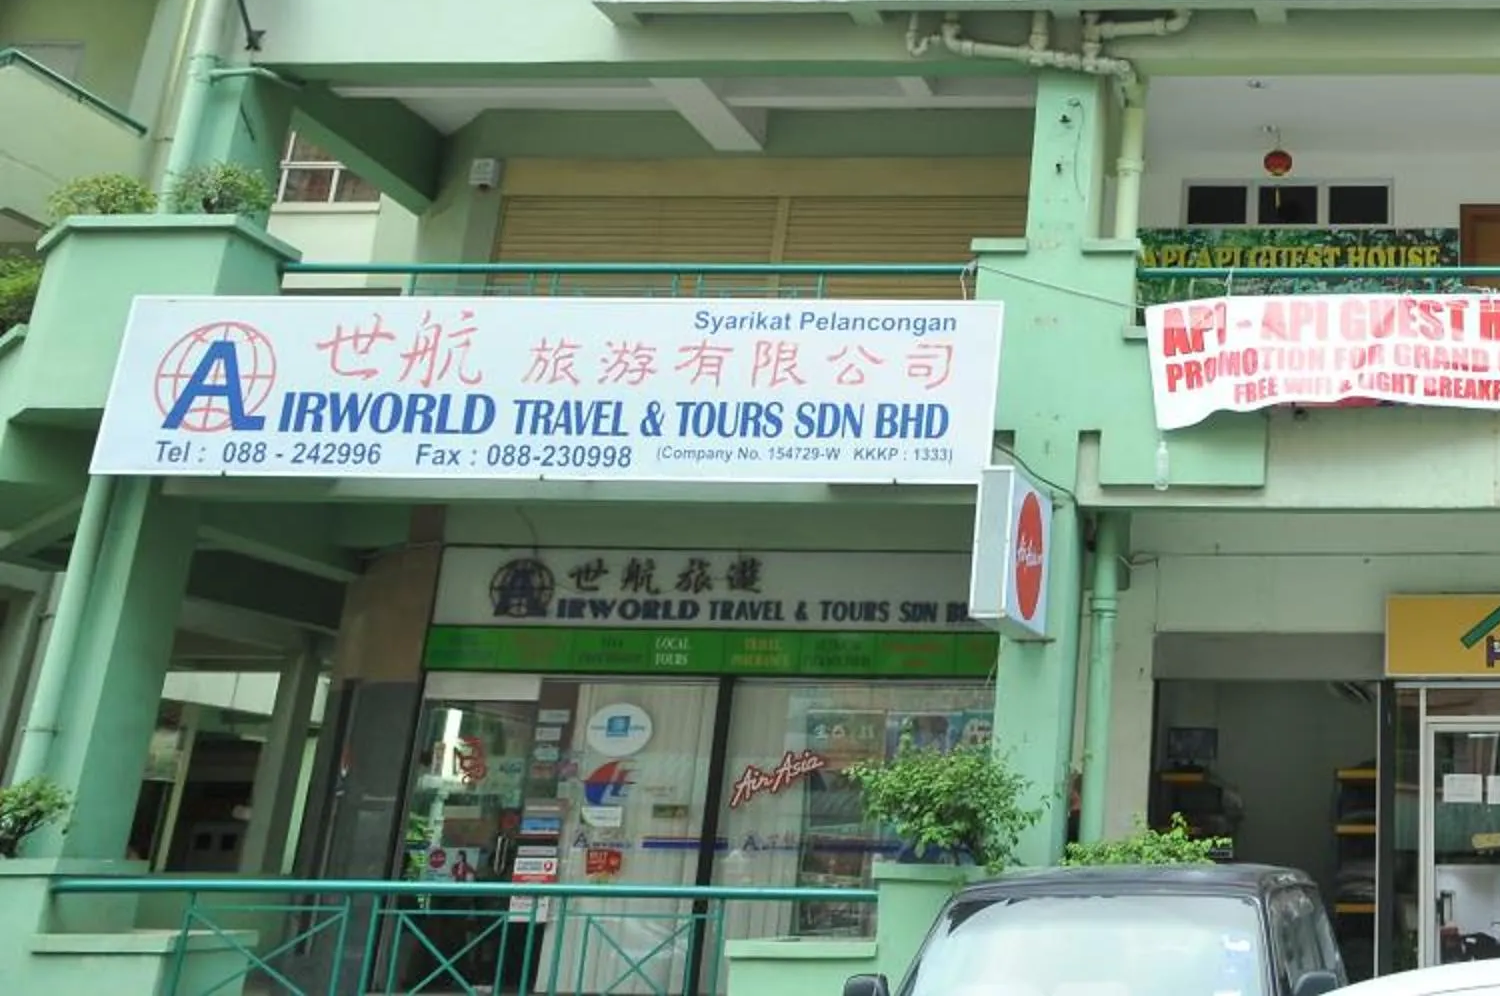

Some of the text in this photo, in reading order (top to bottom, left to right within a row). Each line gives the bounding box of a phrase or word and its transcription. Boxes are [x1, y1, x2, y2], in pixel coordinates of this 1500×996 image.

[694, 310, 957, 336] Syarikat Pelancongan
[1338, 297, 1470, 341] GUEST
[1166, 345, 1326, 393] PROMOTION
[1334, 344, 1385, 371] FOR
[1393, 346, 1490, 373] GRAND
[1233, 375, 1278, 404] FREE
[1357, 373, 1417, 396] LIGHT
[513, 399, 629, 437] TRAVEL
[639, 402, 664, 437] &
[675, 401, 785, 438] TOURS
[794, 402, 865, 440] SDN
[874, 403, 949, 440] BHD
[291, 442, 382, 465] 242996
[487, 444, 632, 468] 088-230998
[709, 600, 784, 621] TRAVEL
[794, 601, 809, 621] &
[821, 600, 889, 622] TOURS
[898, 601, 937, 622] SDN
